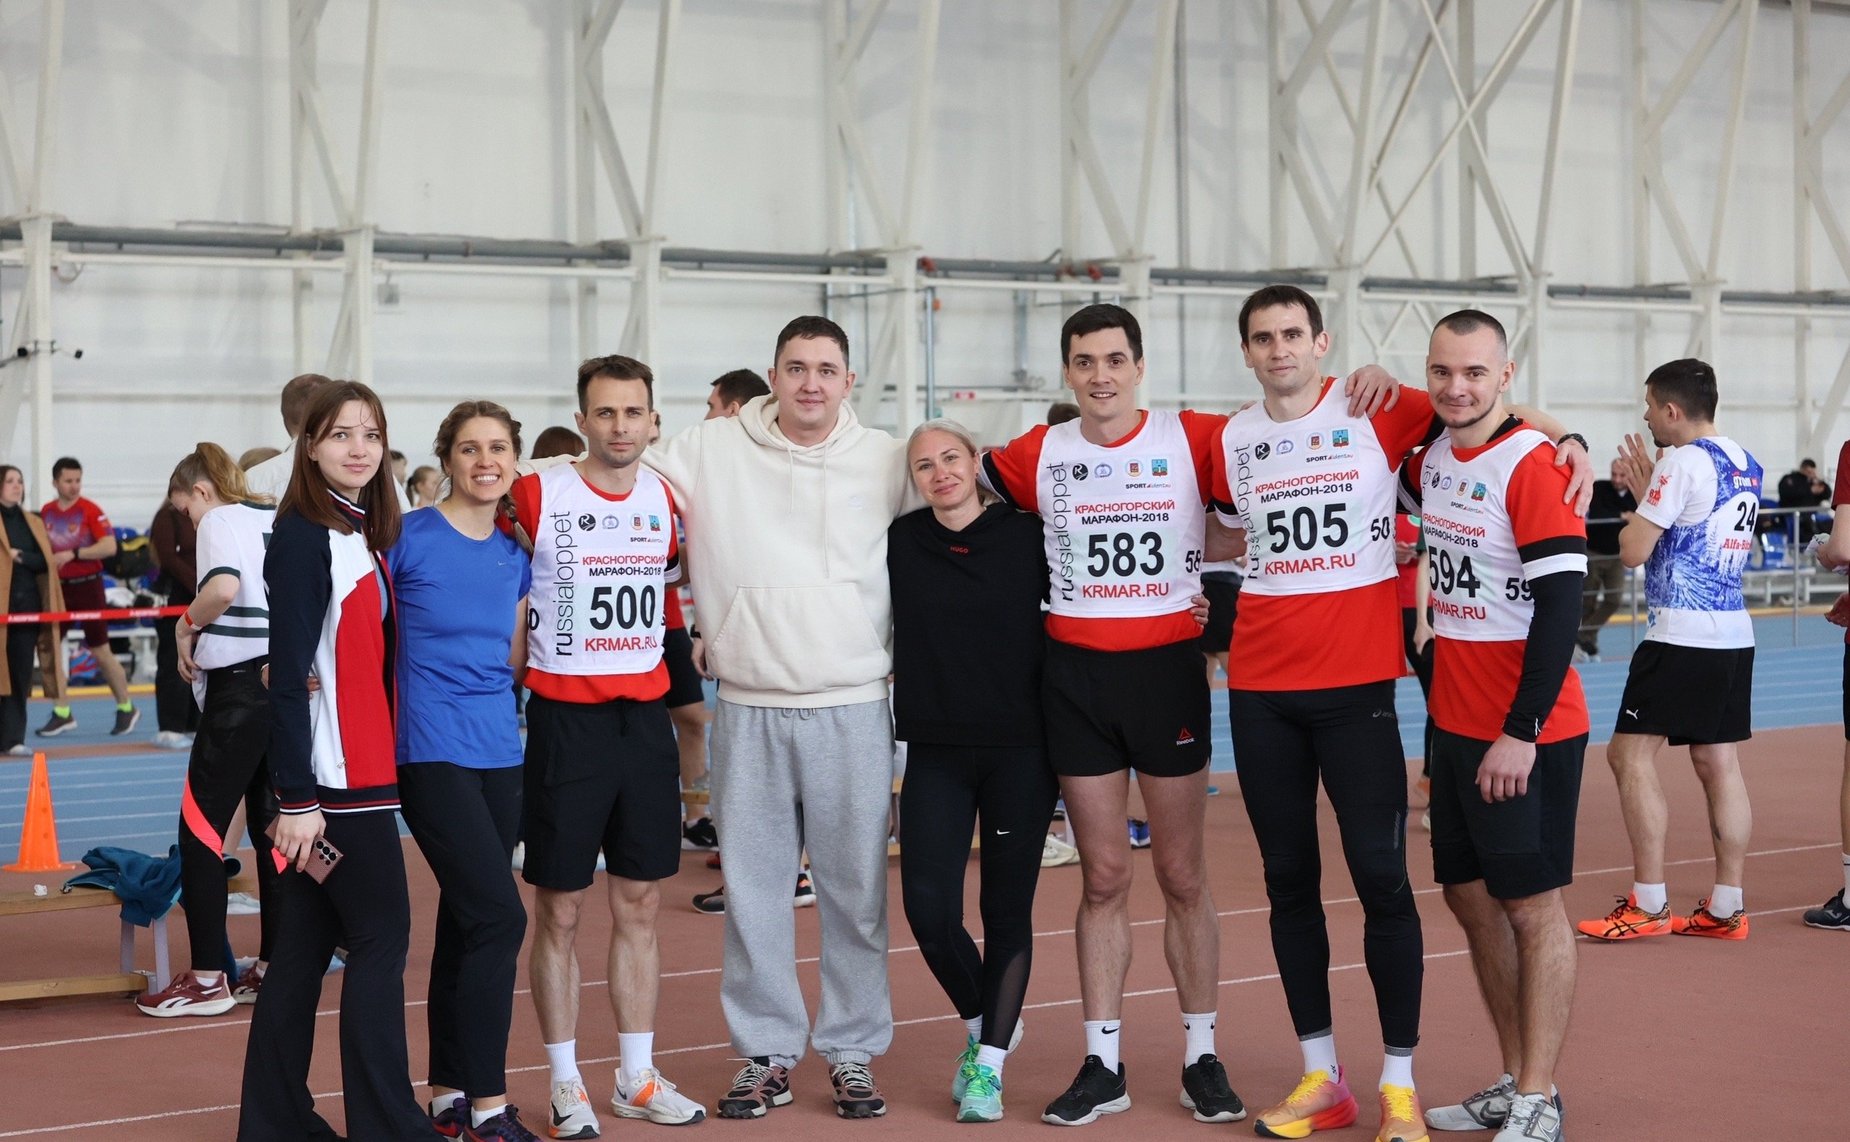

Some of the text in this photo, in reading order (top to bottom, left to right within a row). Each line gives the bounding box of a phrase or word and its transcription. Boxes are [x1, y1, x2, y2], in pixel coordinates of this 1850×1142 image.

[1255, 469, 1360, 495] КРАСНОГОРСКИЙ
[1260, 483, 1353, 504] МАРАФОН-2018
[1074, 499, 1176, 515] КРАСНОГОРСКИЙ
[1081, 512, 1170, 525] МАРАФОН-2018
[1734, 501, 1756, 532] 24
[1047, 461, 1075, 602] russialoppet
[1267, 503, 1349, 554] 505
[1370, 516, 1397, 542] 50
[582, 554, 667, 566] КРАСНОГОРСКИЙ
[950, 546, 969, 554] HUGO
[1087, 531, 1165, 577] 583
[1185, 549, 1201, 573] 58
[589, 566, 662, 577] МАРАФОН-2018
[1265, 553, 1357, 575] KRMAR.RU
[1428, 546, 1481, 598] 594
[550, 511, 578, 657] russialoppet
[1082, 582, 1170, 598] KRMAR.RU
[1505, 577, 1533, 601] 59
[589, 584, 657, 631] 500
[1432, 597, 1487, 620] RMAR.RU
[584, 636, 658, 652] KRMAR.RU
